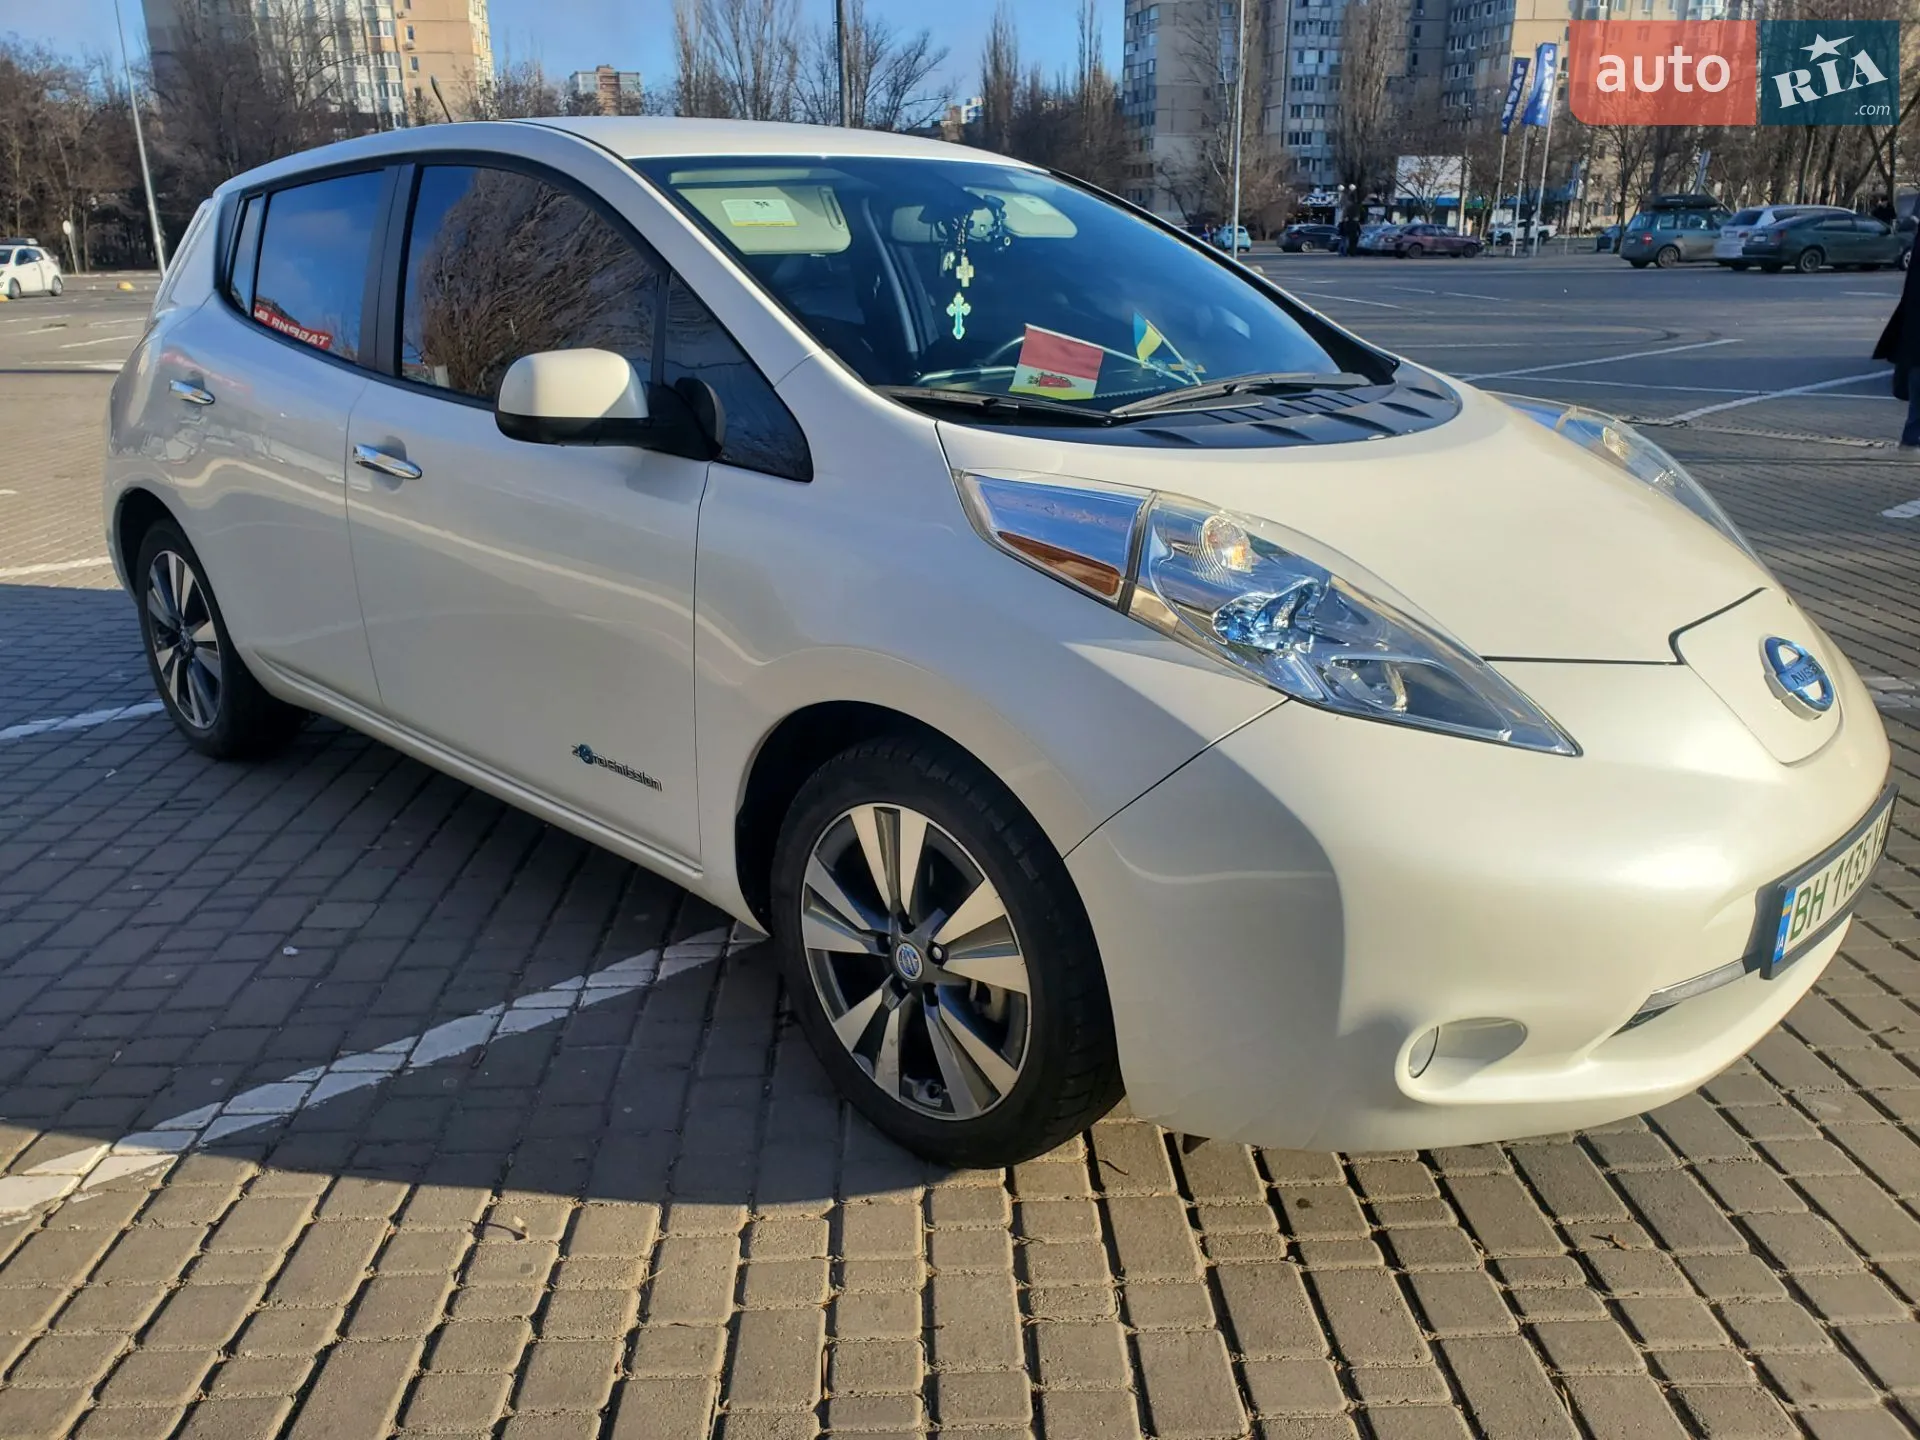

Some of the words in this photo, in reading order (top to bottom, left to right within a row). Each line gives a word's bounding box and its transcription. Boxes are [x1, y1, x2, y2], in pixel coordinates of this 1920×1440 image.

[1790, 662, 1818, 686] NIS
[1789, 872, 1829, 942] BH
[1833, 832, 1871, 908] 1135
